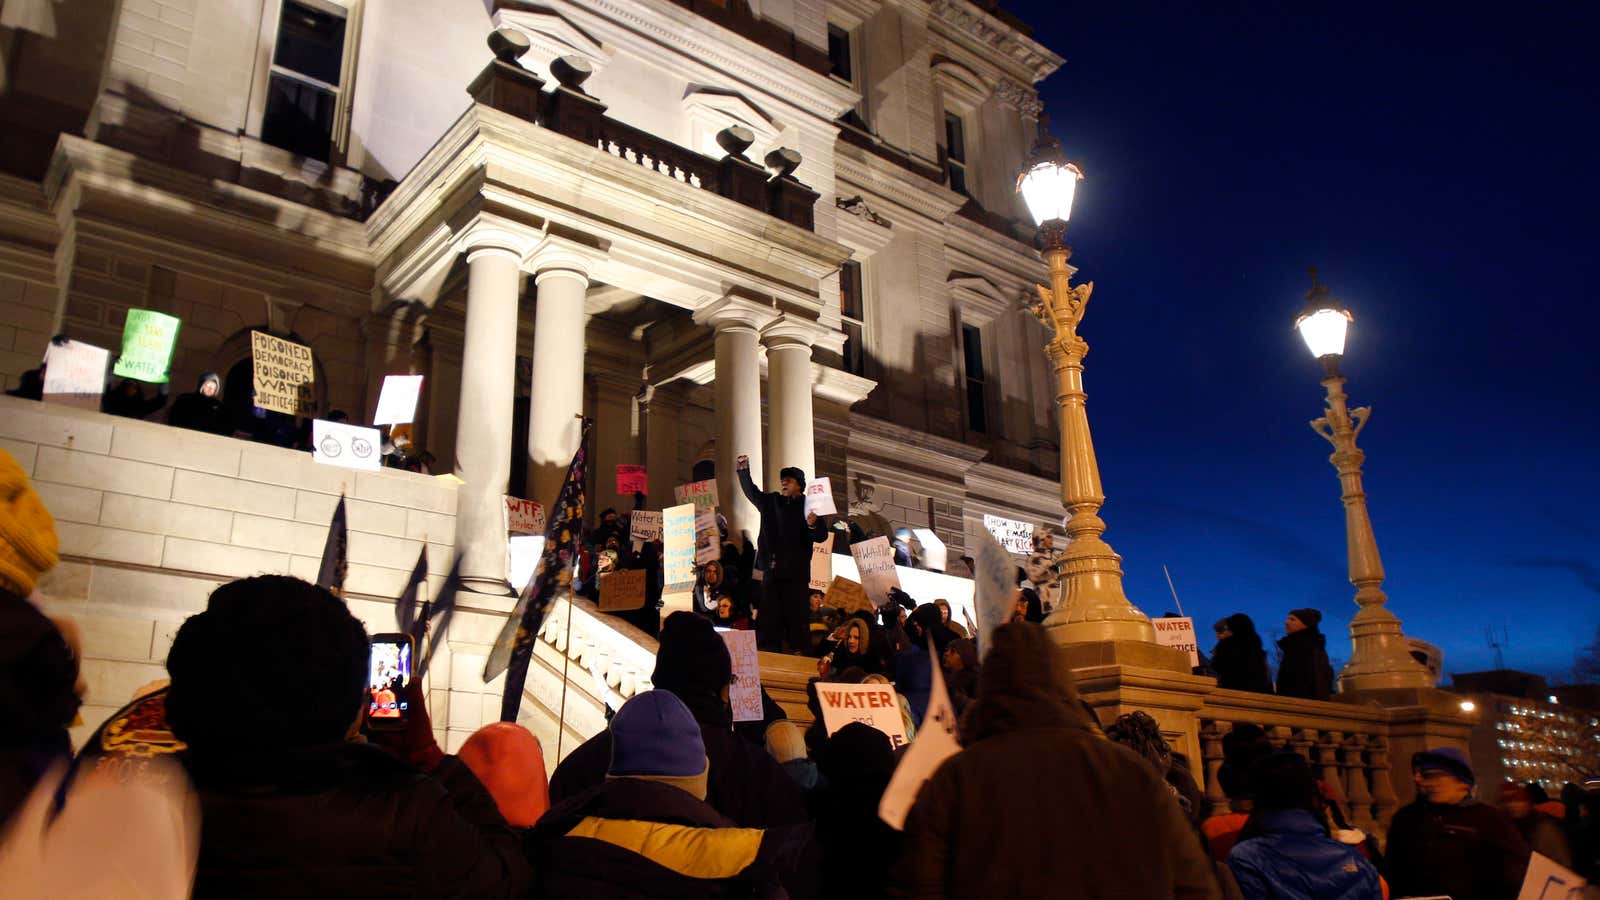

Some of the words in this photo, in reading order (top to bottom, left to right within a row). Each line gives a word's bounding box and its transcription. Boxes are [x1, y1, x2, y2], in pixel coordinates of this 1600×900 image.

[254, 332, 310, 361] POISONED
[254, 349, 312, 373] DEMOCRACY
[255, 362, 310, 384] POISONED
[684, 480, 709, 496] FIRE
[632, 511, 654, 523] Water
[1155, 621, 1191, 631] WATER
[822, 690, 894, 709] WATER
